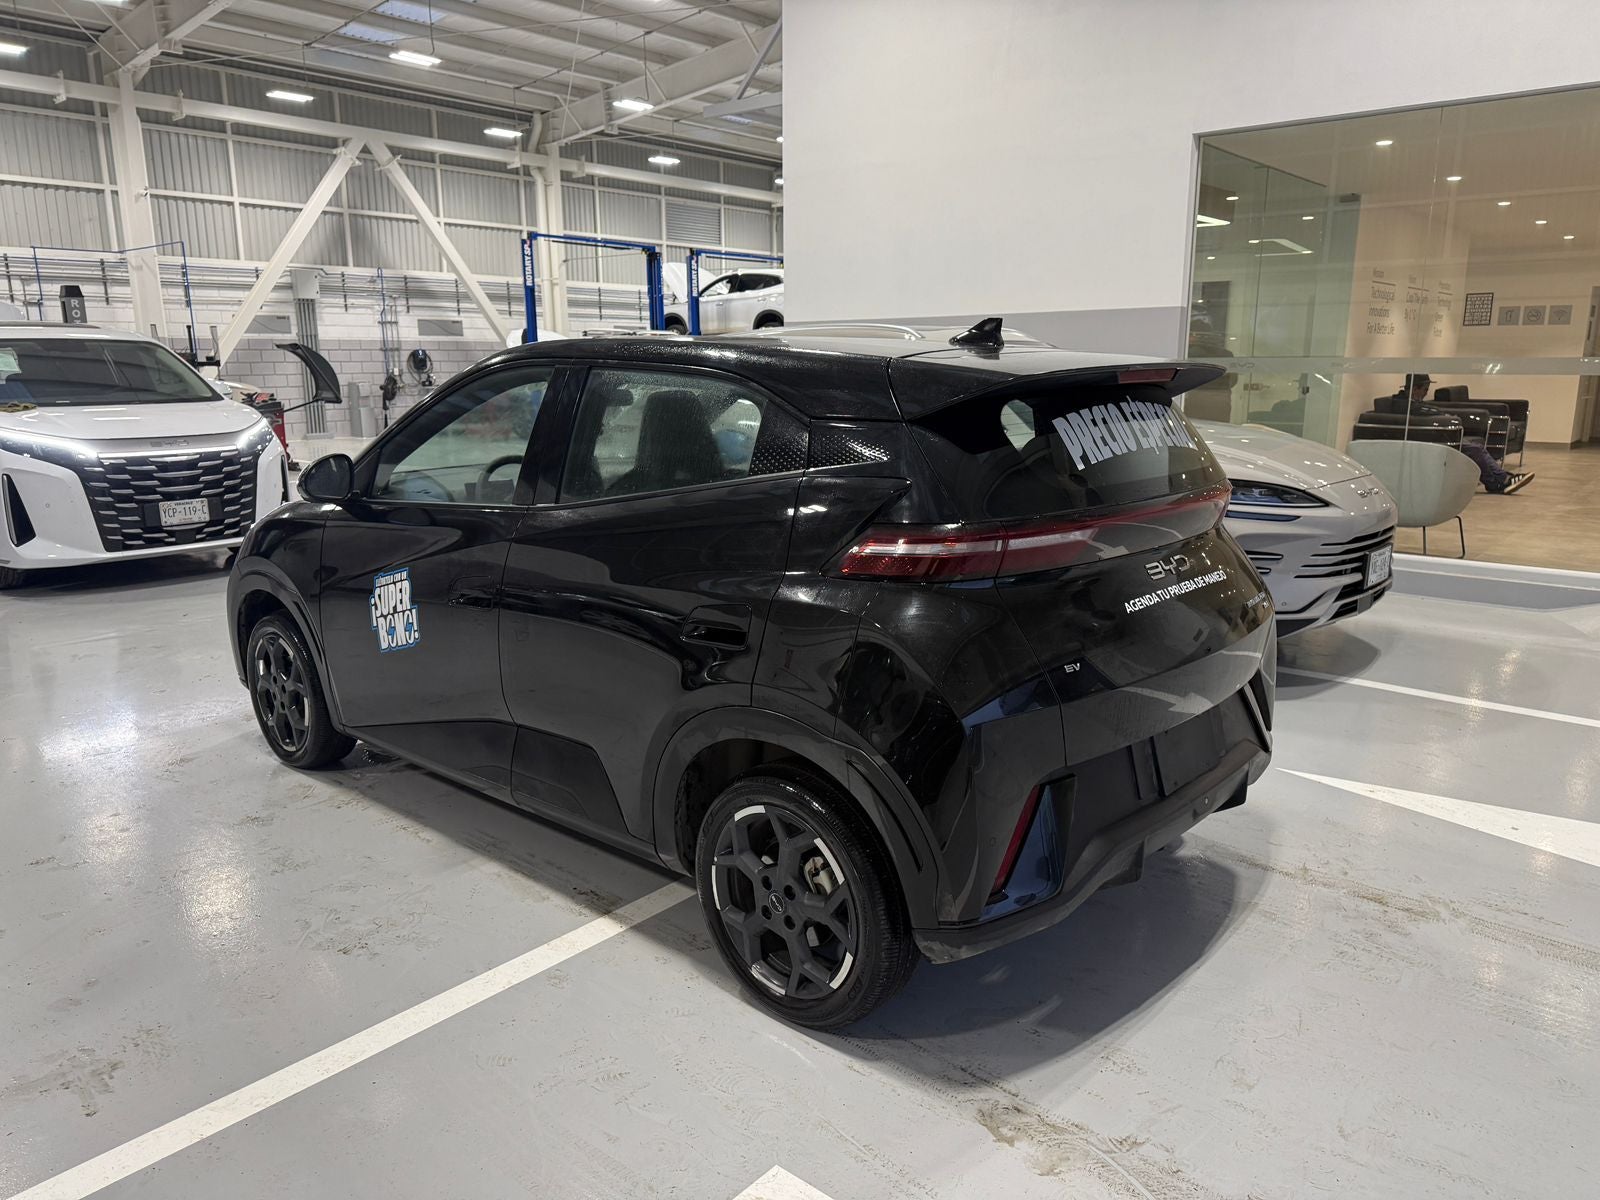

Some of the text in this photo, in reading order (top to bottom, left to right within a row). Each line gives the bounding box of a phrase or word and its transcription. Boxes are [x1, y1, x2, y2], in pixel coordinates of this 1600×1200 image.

[525, 256, 533, 286] ROTARY
[1052, 403, 1138, 471] PRECIO
[162, 504, 207, 519] YCP-119-C
[1145, 554, 1190, 581] BYD
[1124, 570, 1227, 614] AGENDA TU PRUEBA DE MANEJO
[377, 609, 419, 650] BONO!
[1064, 662, 1080, 673] EV
